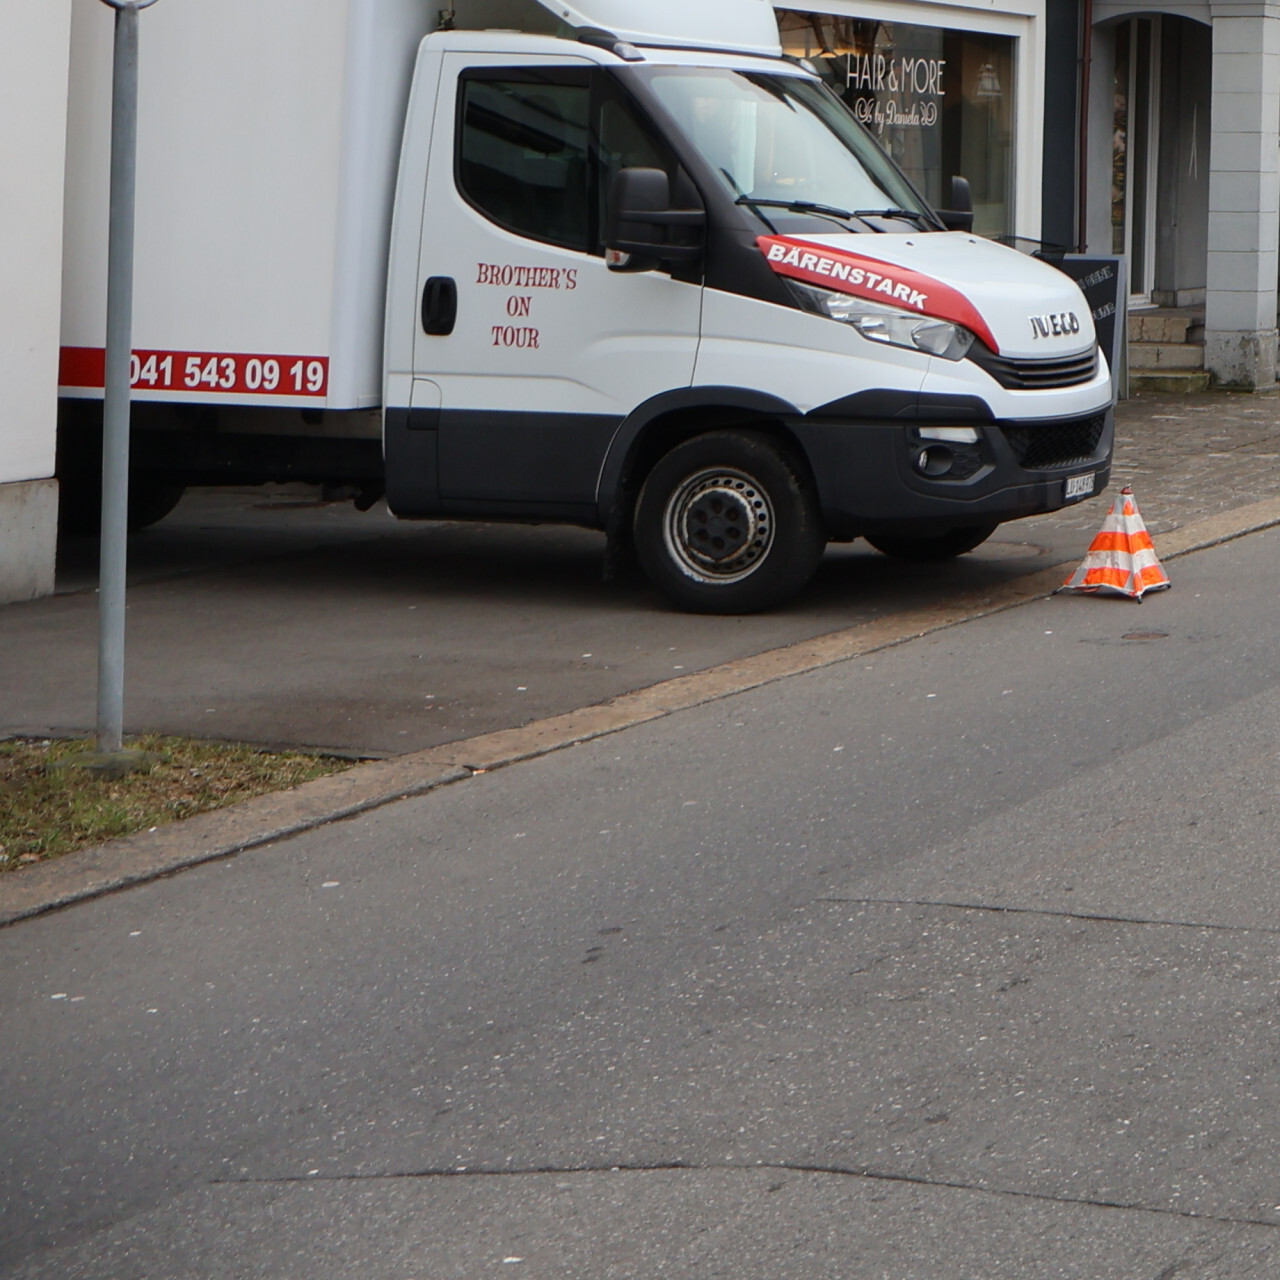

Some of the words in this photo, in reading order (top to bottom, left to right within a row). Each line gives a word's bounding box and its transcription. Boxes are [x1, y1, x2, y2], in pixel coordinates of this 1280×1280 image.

[846, 52, 886, 91] HAIR
[901, 56, 947, 95] MORE
[874, 101, 885, 134] by
[886, 100, 920, 126] Daniela
[476, 262, 578, 290] BROTHER'S
[767, 243, 929, 311] BÄRENSTARK
[506, 295, 533, 317] ON
[491, 325, 540, 349] TOUR
[1027, 310, 1080, 339] IVECO
[184, 356, 236, 388] 543
[245, 358, 281, 390] 09
[289, 360, 324, 392] 19
